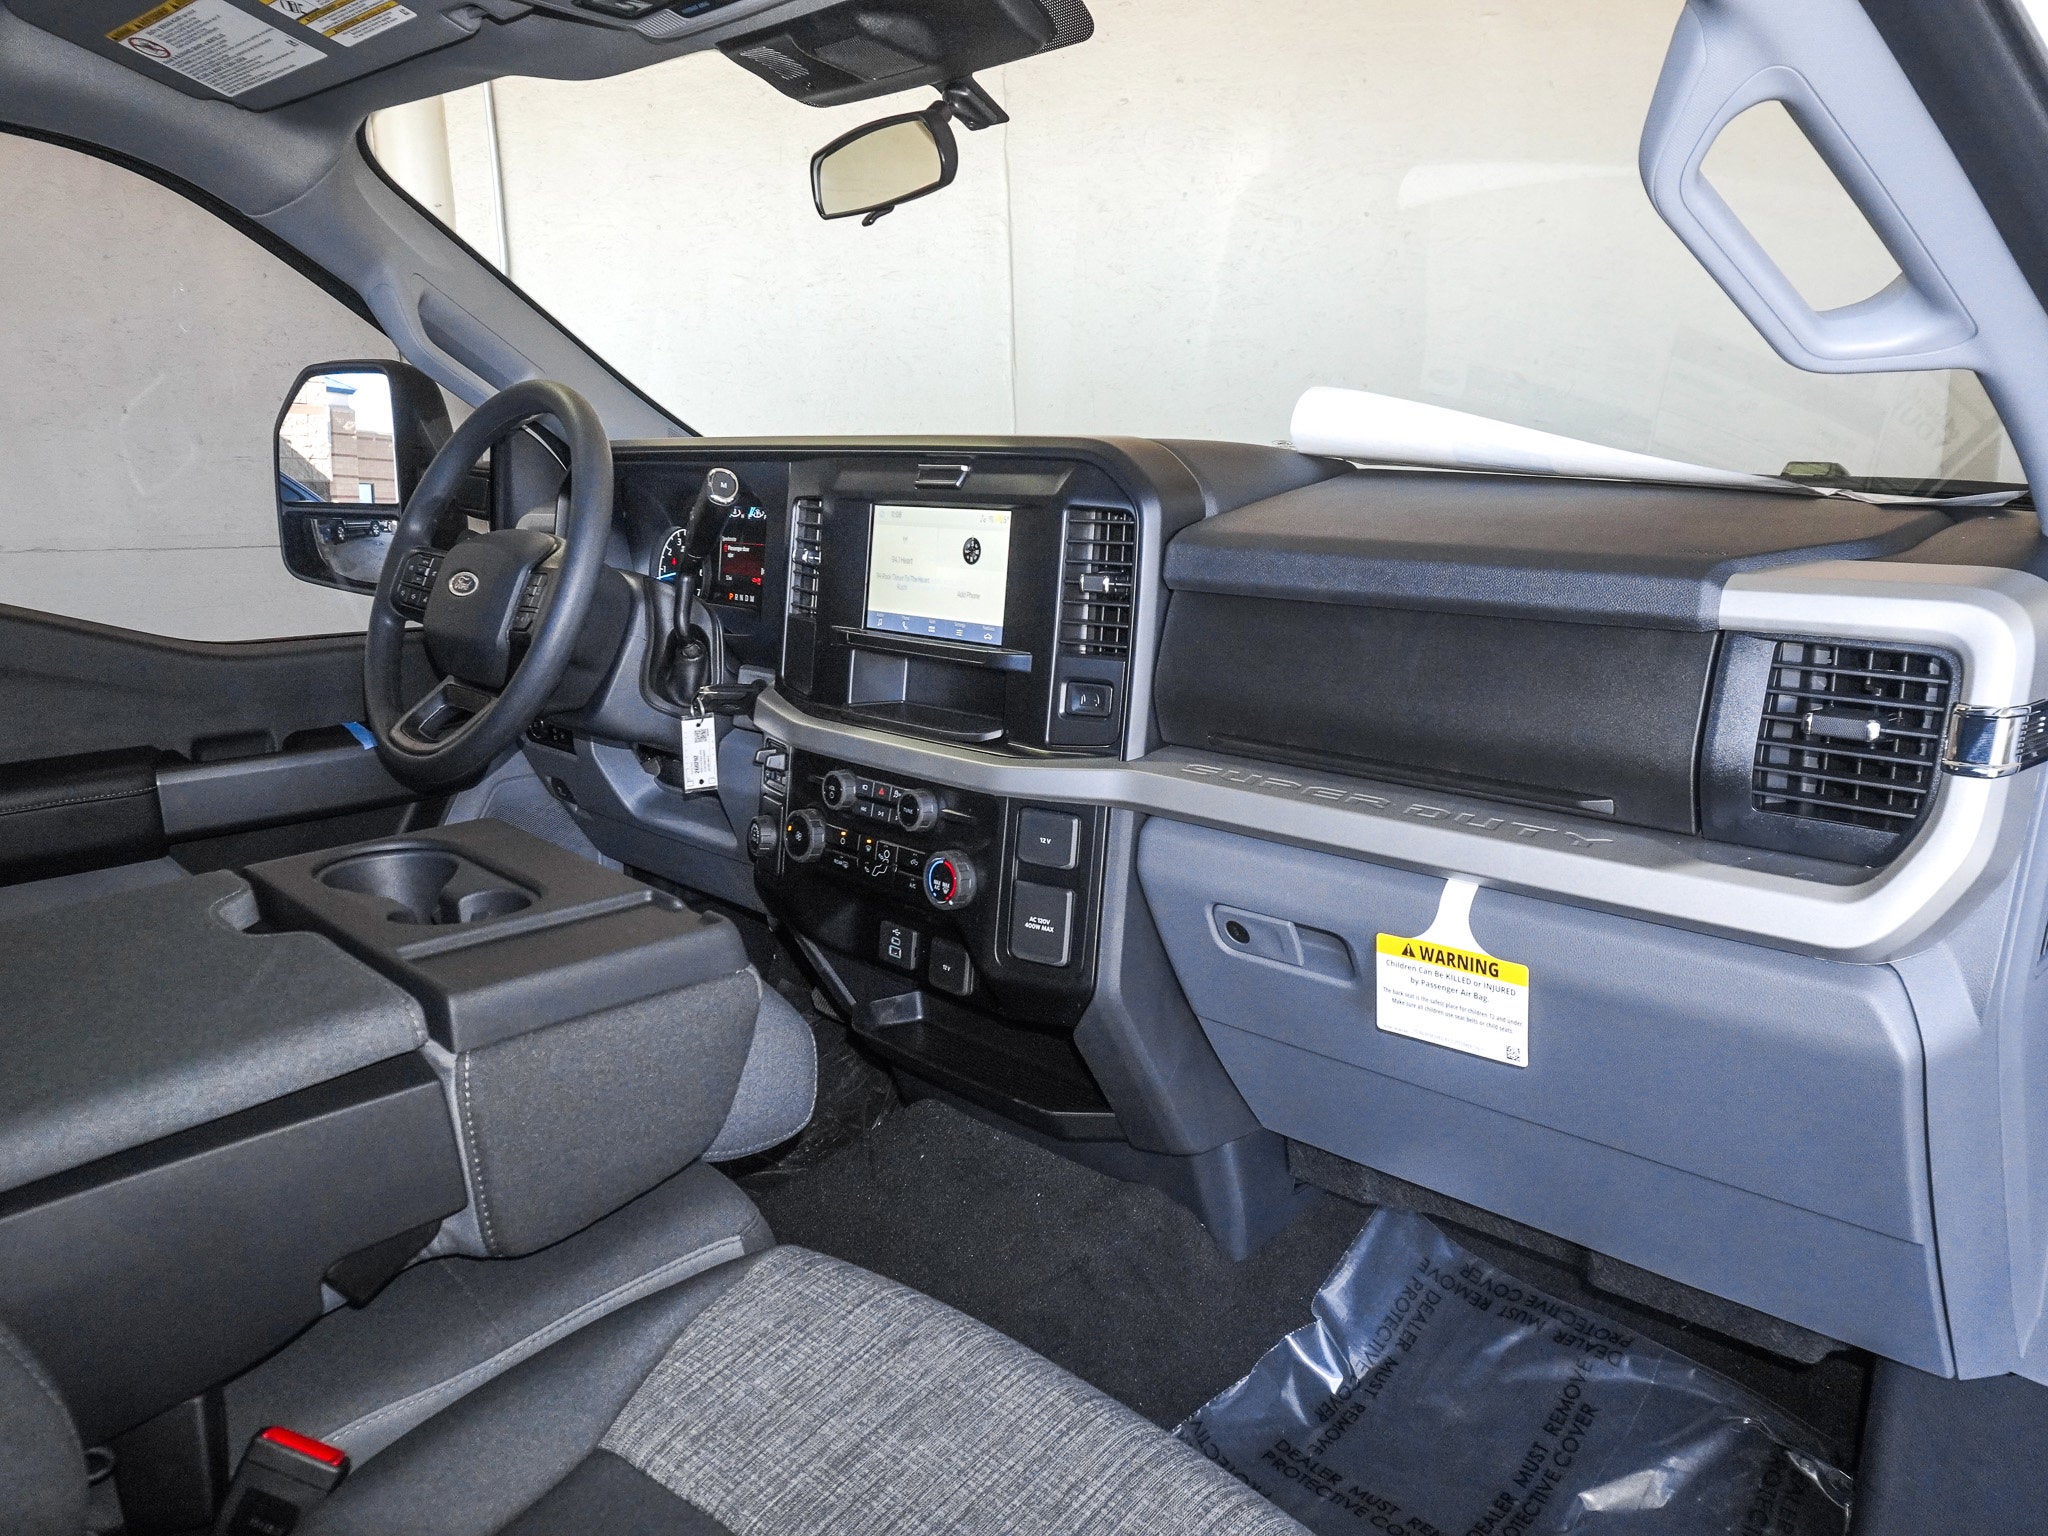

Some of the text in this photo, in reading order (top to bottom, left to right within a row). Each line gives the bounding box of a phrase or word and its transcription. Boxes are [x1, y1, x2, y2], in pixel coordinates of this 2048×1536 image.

[1182, 763, 1614, 848] SUPER DUTY
[1024, 922, 1055, 933] 400W MAX
[1037, 917, 1051, 925] 120V
[1386, 959, 1417, 972] Children
[1418, 966, 1433, 976] Can
[1434, 970, 1444, 979] Be
[1445, 973, 1472, 985] KILLED
[1483, 982, 1516, 997] INJURED
[1410, 977, 1419, 986] by
[1421, 977, 1459, 994] Passenger
[1460, 988, 1471, 998] Air
[1419, 945, 1499, 978] WARNING
[1424, 1006, 1444, 1016] children
[1467, 1008, 1488, 1018] children
[1356, 1274, 1425, 1374] PROTECTIVE
[1416, 1257, 1625, 1368] DEALER MUST REMOVE
[1459, 1261, 1635, 1349] PROTECTIVE COVER
[1307, 1287, 1442, 1457] DEALER MUST REMOVE
[1512, 1441, 1550, 1490] MUST
[1542, 1357, 1594, 1438] REMOVE
[1553, 1402, 1600, 1468] COVER
[1261, 1450, 1369, 1519] PROTECTIVE
[1274, 1437, 1343, 1486] DEALER
[1348, 1484, 1402, 1517] MUST
